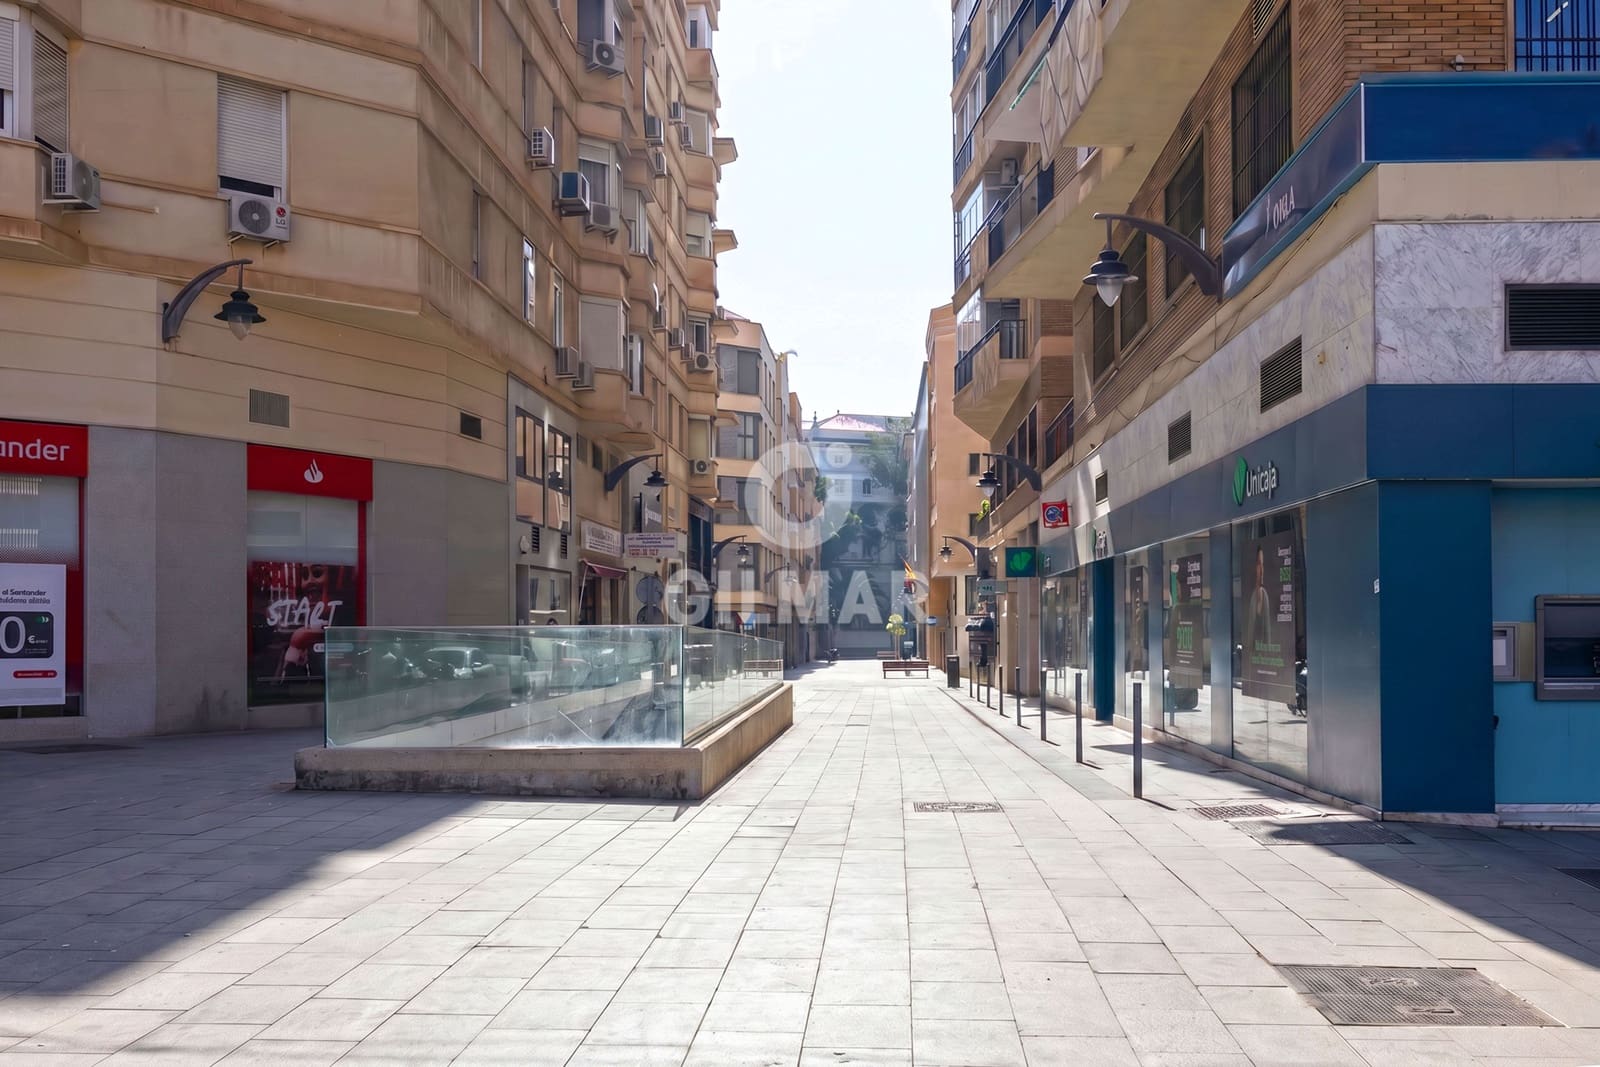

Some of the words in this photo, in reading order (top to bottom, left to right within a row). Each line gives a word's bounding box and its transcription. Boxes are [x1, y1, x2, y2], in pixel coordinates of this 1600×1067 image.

[1246, 460, 1277, 500] Unicaja
[10, 588, 47, 597] Santander
[266, 596, 343, 629] START
